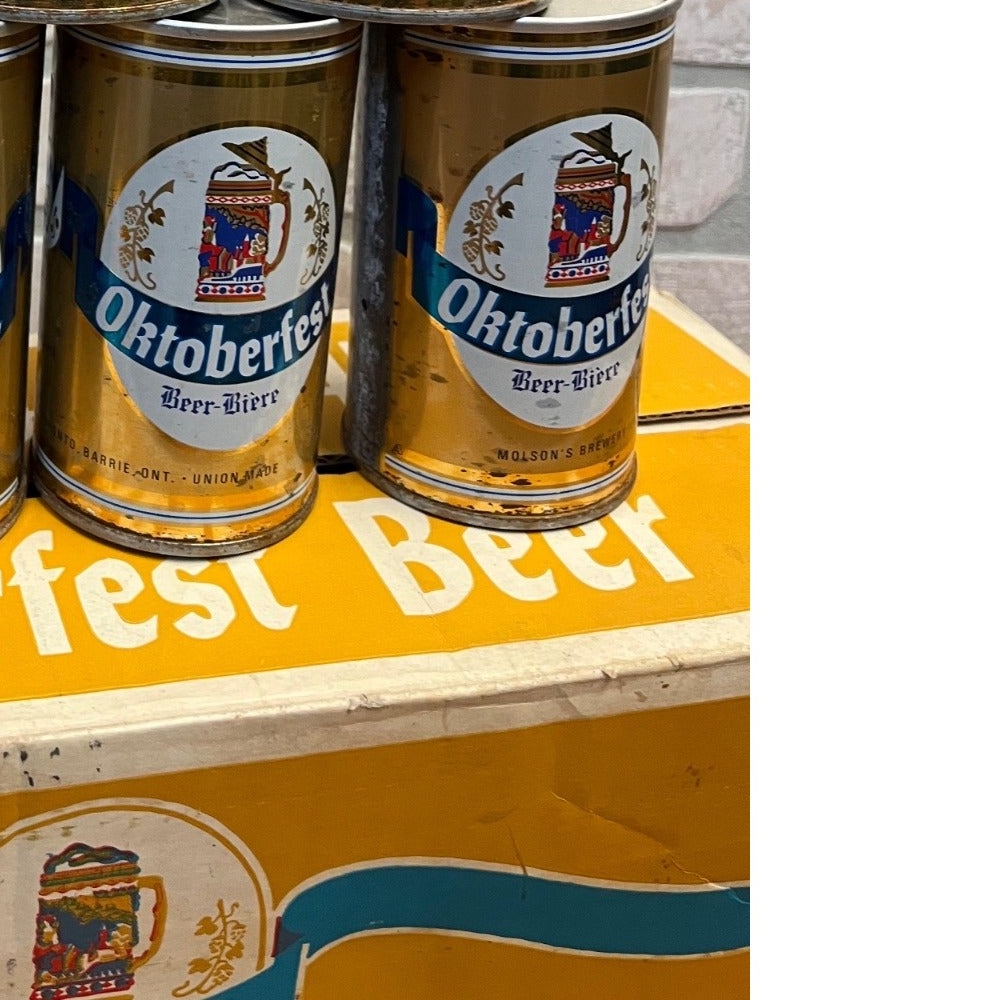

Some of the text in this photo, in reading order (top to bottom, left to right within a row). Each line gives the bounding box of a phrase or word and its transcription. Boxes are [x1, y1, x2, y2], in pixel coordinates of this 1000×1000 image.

[96, 282, 329, 379] Oktoberfest
[511, 360, 621, 394] Beer-Bière
[160, 384, 280, 416] Beer-Bière
[497, 446, 574, 461] MOLSON'S
[192, 472, 238, 485] UNION
[331, 491, 696, 617] Beer
